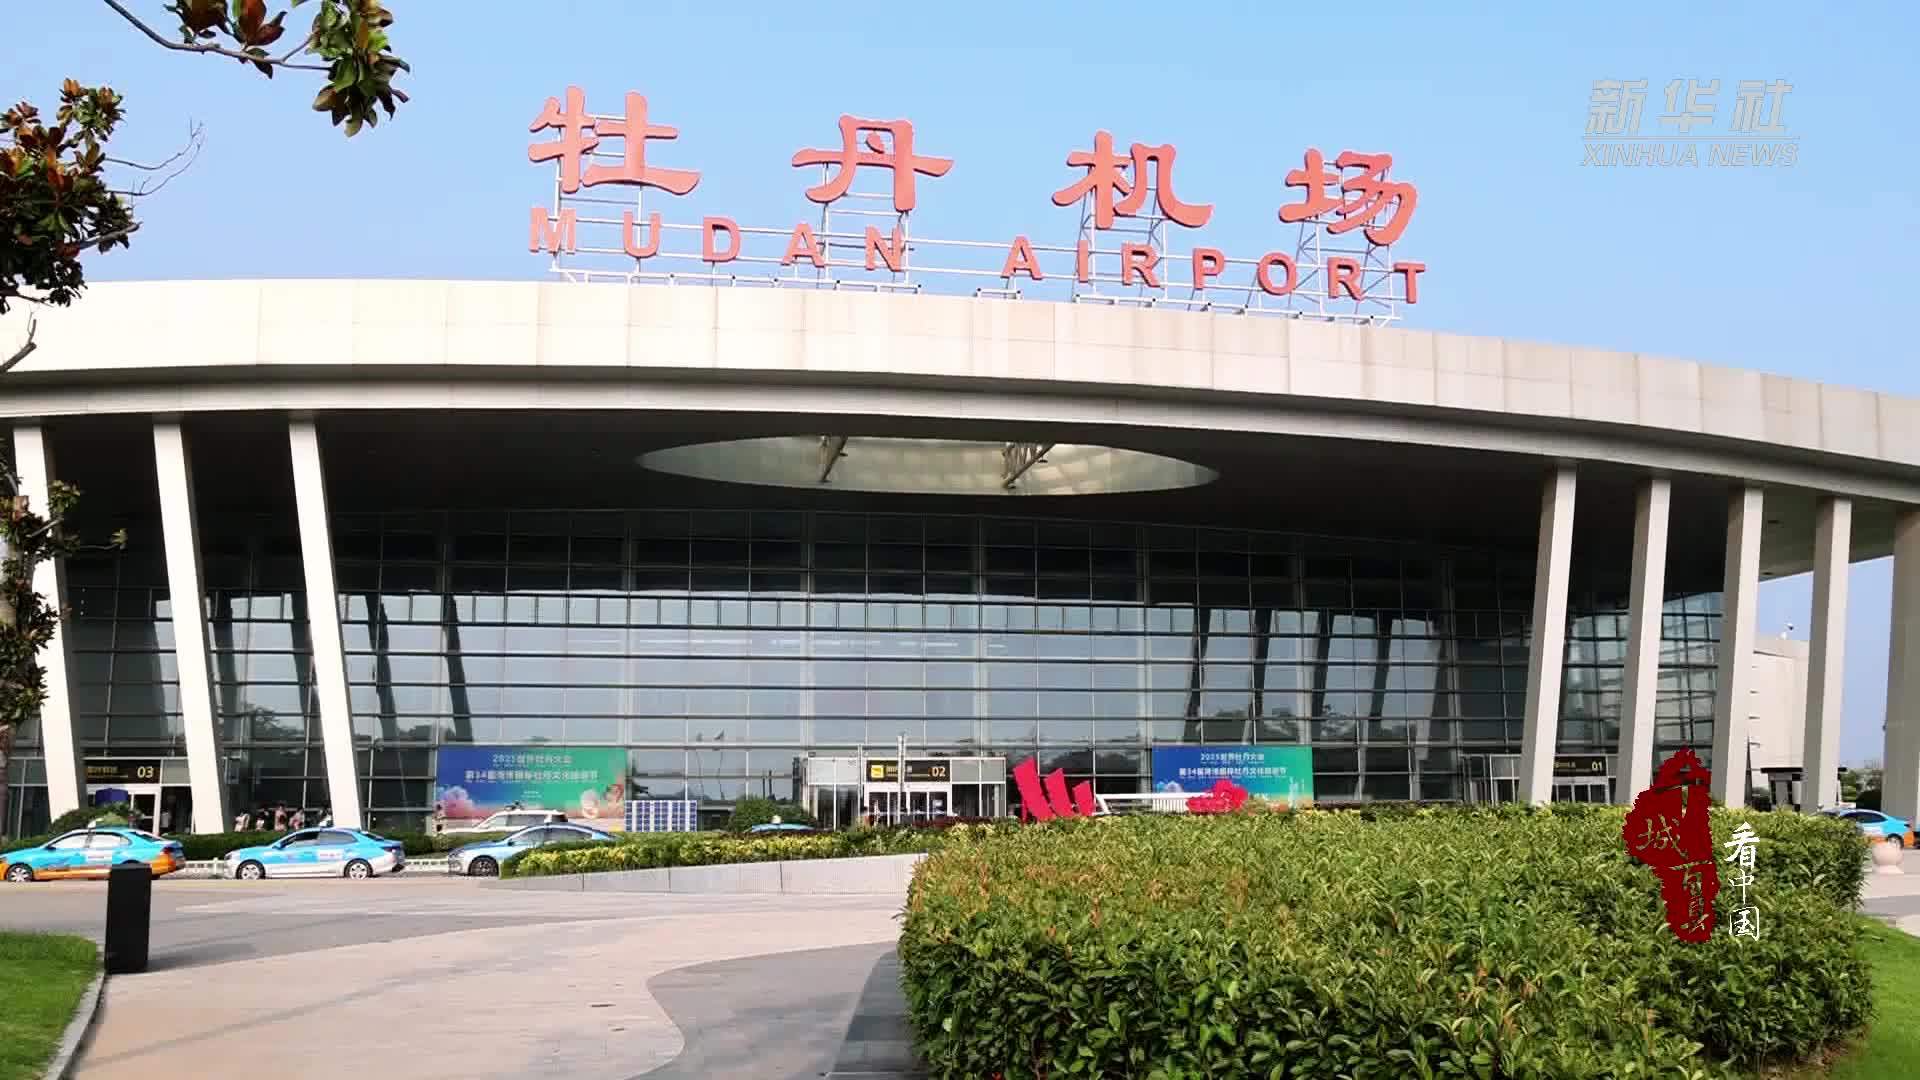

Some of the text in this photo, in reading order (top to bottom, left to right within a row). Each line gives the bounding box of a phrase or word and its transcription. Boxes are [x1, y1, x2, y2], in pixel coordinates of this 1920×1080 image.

[528, 85, 1418, 247] 牡丹机场
[529, 206, 1427, 305] MUDAN AIRPORT
[137, 766, 154, 778] 03
[931, 766, 946, 777] 02
[1591, 761, 1603, 771] 01
